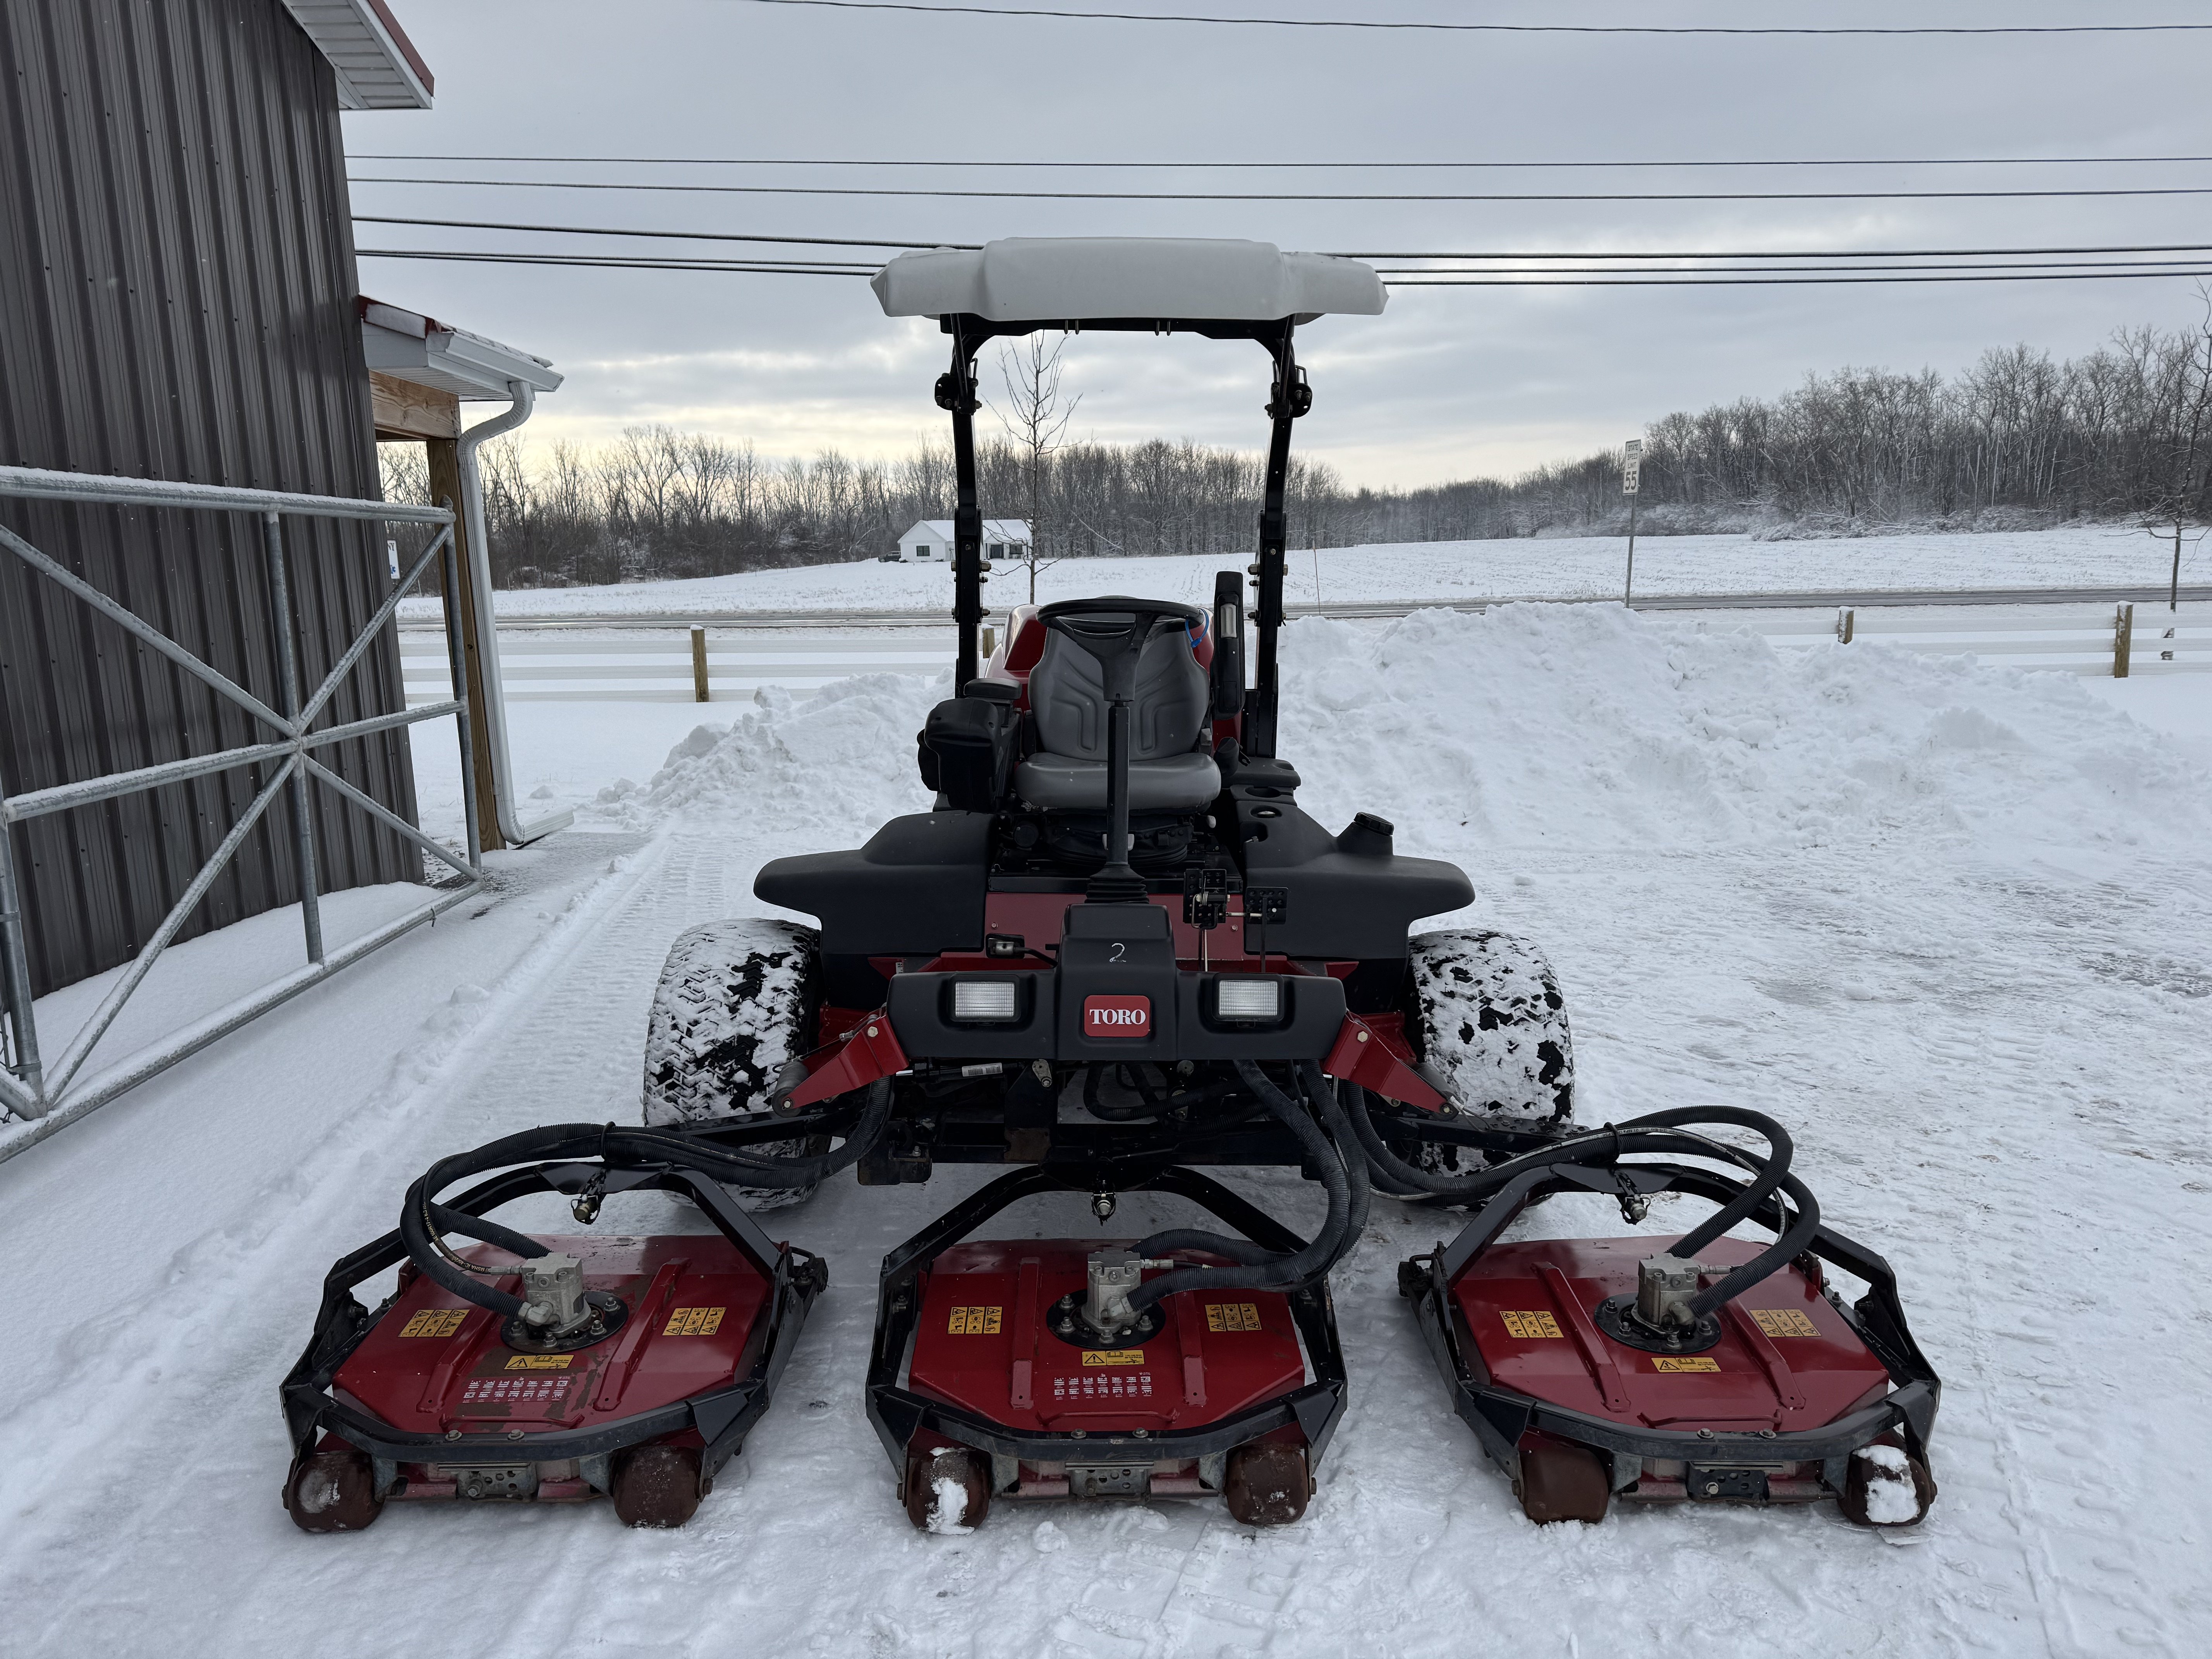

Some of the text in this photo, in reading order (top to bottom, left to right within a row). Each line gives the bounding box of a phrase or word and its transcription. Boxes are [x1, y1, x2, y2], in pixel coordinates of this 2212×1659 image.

[1625, 471, 1637, 490] 55
[1109, 943, 1127, 963] 2
[1089, 1009, 1146, 1025] TORO
